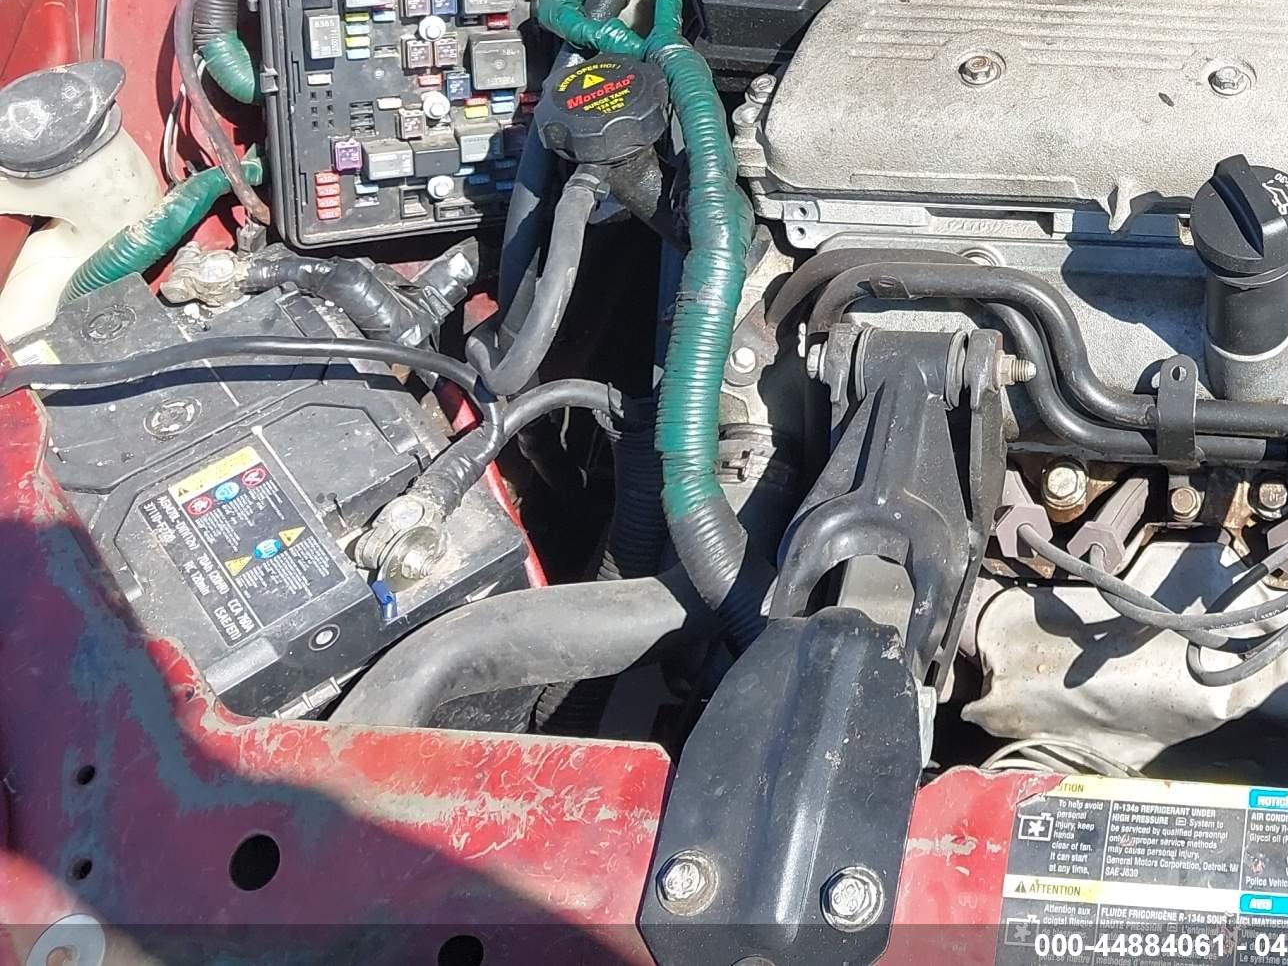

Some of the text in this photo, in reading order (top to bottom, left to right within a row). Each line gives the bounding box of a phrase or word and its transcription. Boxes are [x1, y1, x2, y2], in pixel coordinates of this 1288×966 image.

[1059, 799, 1104, 811] To help avoid
[1056, 811, 1087, 820] personal
[1140, 805, 1191, 817] REFRIGERANT
[1191, 807, 1216, 817] UNDER
[1251, 812, 1264, 821] AIR
[1112, 813, 1224, 829] HIGH PRESSURE System to
[1077, 822, 1095, 832] keep
[1250, 823, 1263, 832] Use
[1265, 824, 1281, 834] only
[1053, 831, 1075, 840] hands
[1110, 824, 1228, 842] be serviced by qualified personnel
[1160, 837, 1186, 847] service
[1187, 838, 1217, 849] methods
[1249, 834, 1271, 844] Glycol
[1272, 835, 1282, 843] oil
[1052, 841, 1070, 850] clear
[1070, 842, 1079, 851] of
[1050, 852, 1088, 863] It can start
[1108, 845, 1123, 855] may
[1124, 847, 1145, 855] cause
[1147, 849, 1178, 859] personal
[1106, 855, 1133, 865] General
[1134, 857, 1158, 867] Motors
[1048, 863, 1057, 872] at
[1057, 865, 1071, 875] any
[1105, 867, 1120, 876] SAE
[1246, 876, 1267, 886] Police
[1029, 883, 1081, 897] ATTENTION
[1044, 904, 1091, 915] Attention aux
[1101, 907, 1128, 918] FLUIDE
[1128, 908, 1178, 922] FRIGORIGÈNE
[1206, 914, 1227, 924] SOUS
[1100, 919, 1125, 930] HAUTE
[1126, 921, 1163, 932] PRESSION
[1239, 953, 1248, 962] Le
